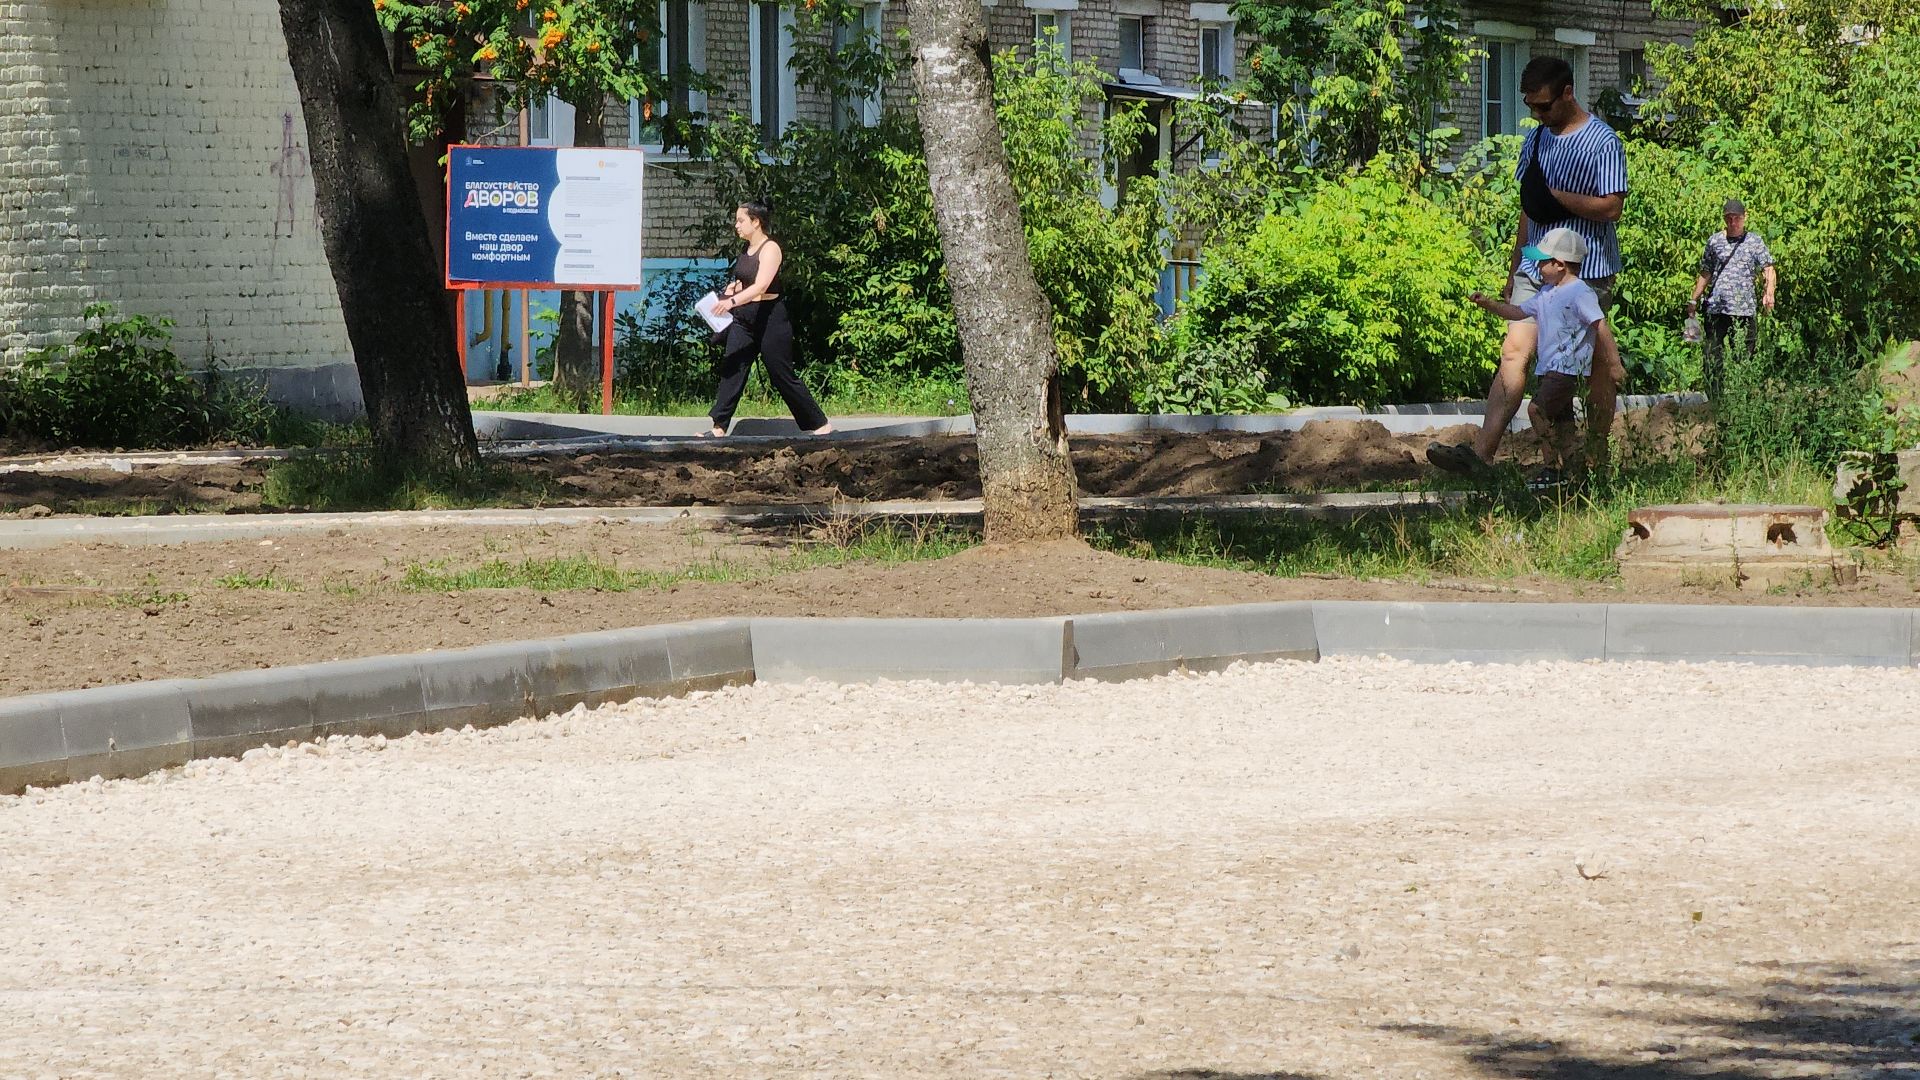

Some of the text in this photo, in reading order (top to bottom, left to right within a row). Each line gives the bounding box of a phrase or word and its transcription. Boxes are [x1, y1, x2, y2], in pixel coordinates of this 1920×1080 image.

[465, 181, 539, 190] БЛАГОУСТРОЙСТВО
[464, 190, 539, 208] ДВОРОВ
[465, 231, 538, 242] Вместе сделаем
[480, 243, 523, 253] наш двор
[472, 251, 531, 262] комфортным
